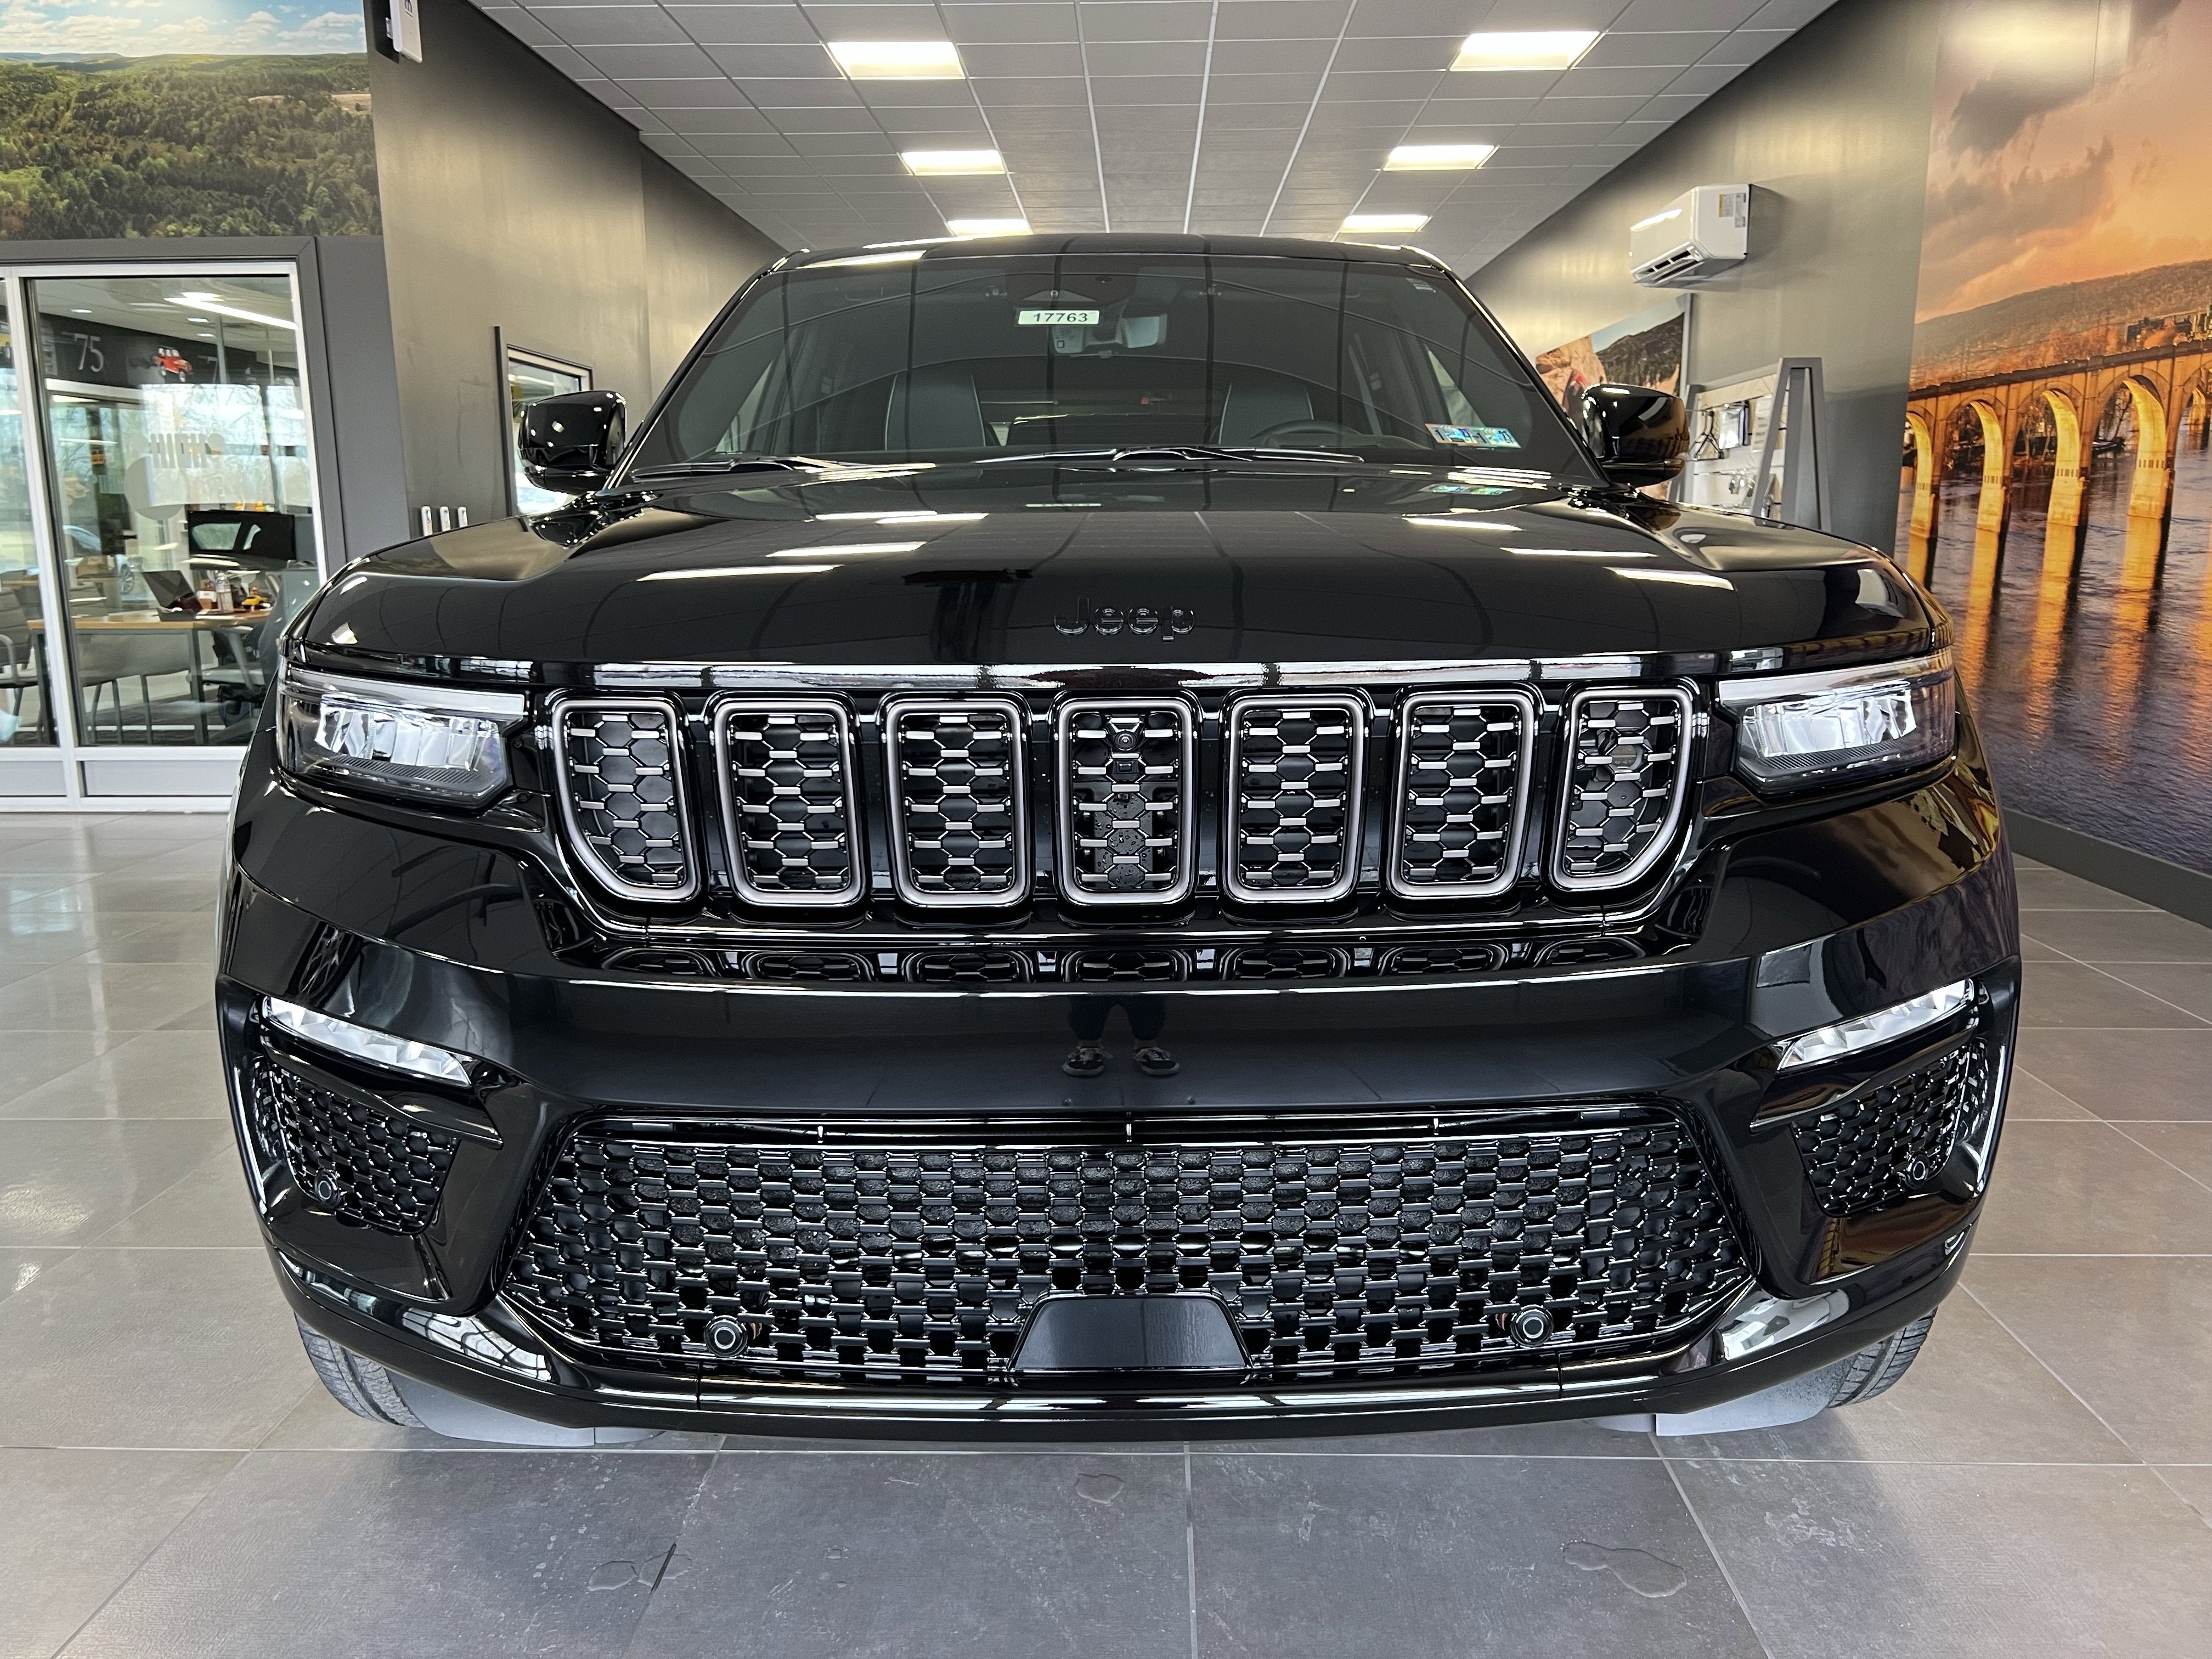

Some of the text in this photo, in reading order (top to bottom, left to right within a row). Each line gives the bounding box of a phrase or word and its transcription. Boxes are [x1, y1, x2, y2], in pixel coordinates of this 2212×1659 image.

[1033, 313, 1088, 323] 17763
[74, 333, 104, 373] 75
[1054, 597, 1195, 643] Jeep
